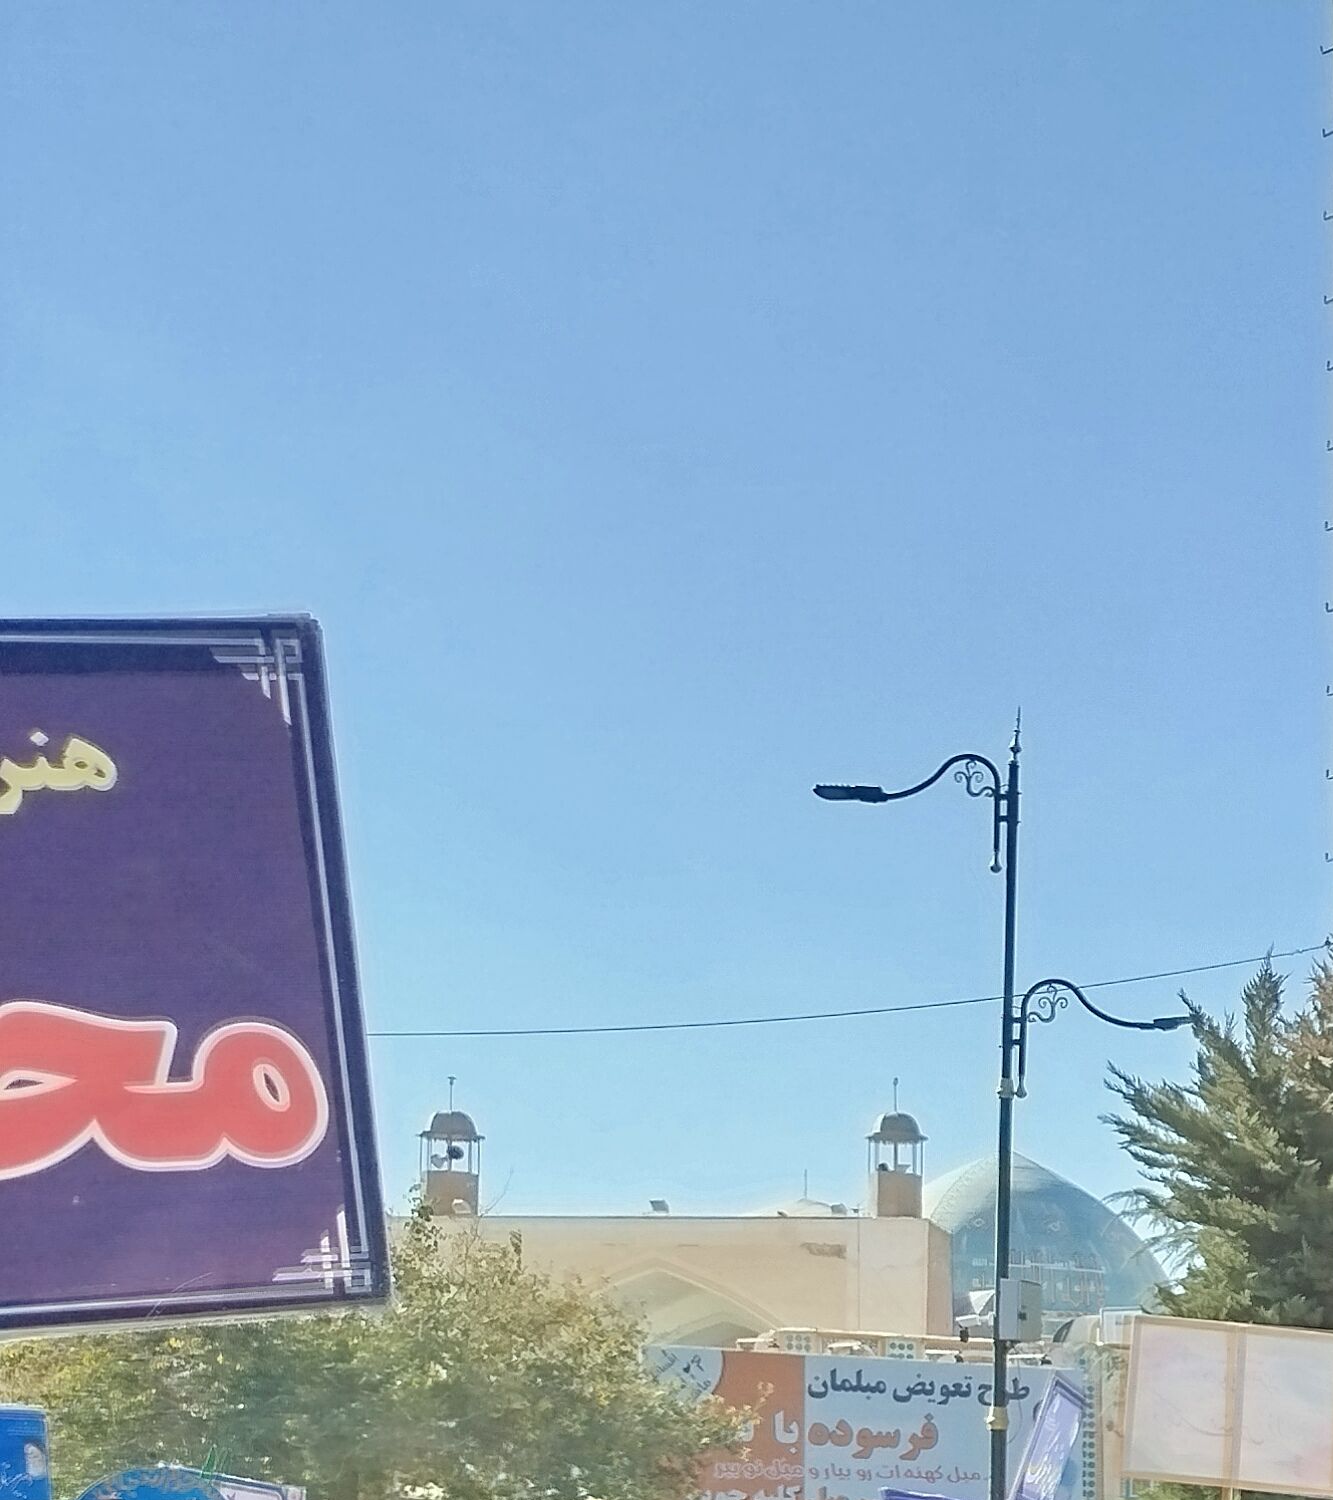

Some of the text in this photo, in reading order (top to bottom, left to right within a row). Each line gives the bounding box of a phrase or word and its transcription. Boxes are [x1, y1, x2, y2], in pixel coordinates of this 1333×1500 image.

[807, 1367, 887, 1401] مبلمان
[893, 1373, 973, 1405] تعویض
[773, 1411, 800, 1453] با
[808, 1412, 939, 1460] فرسوده
